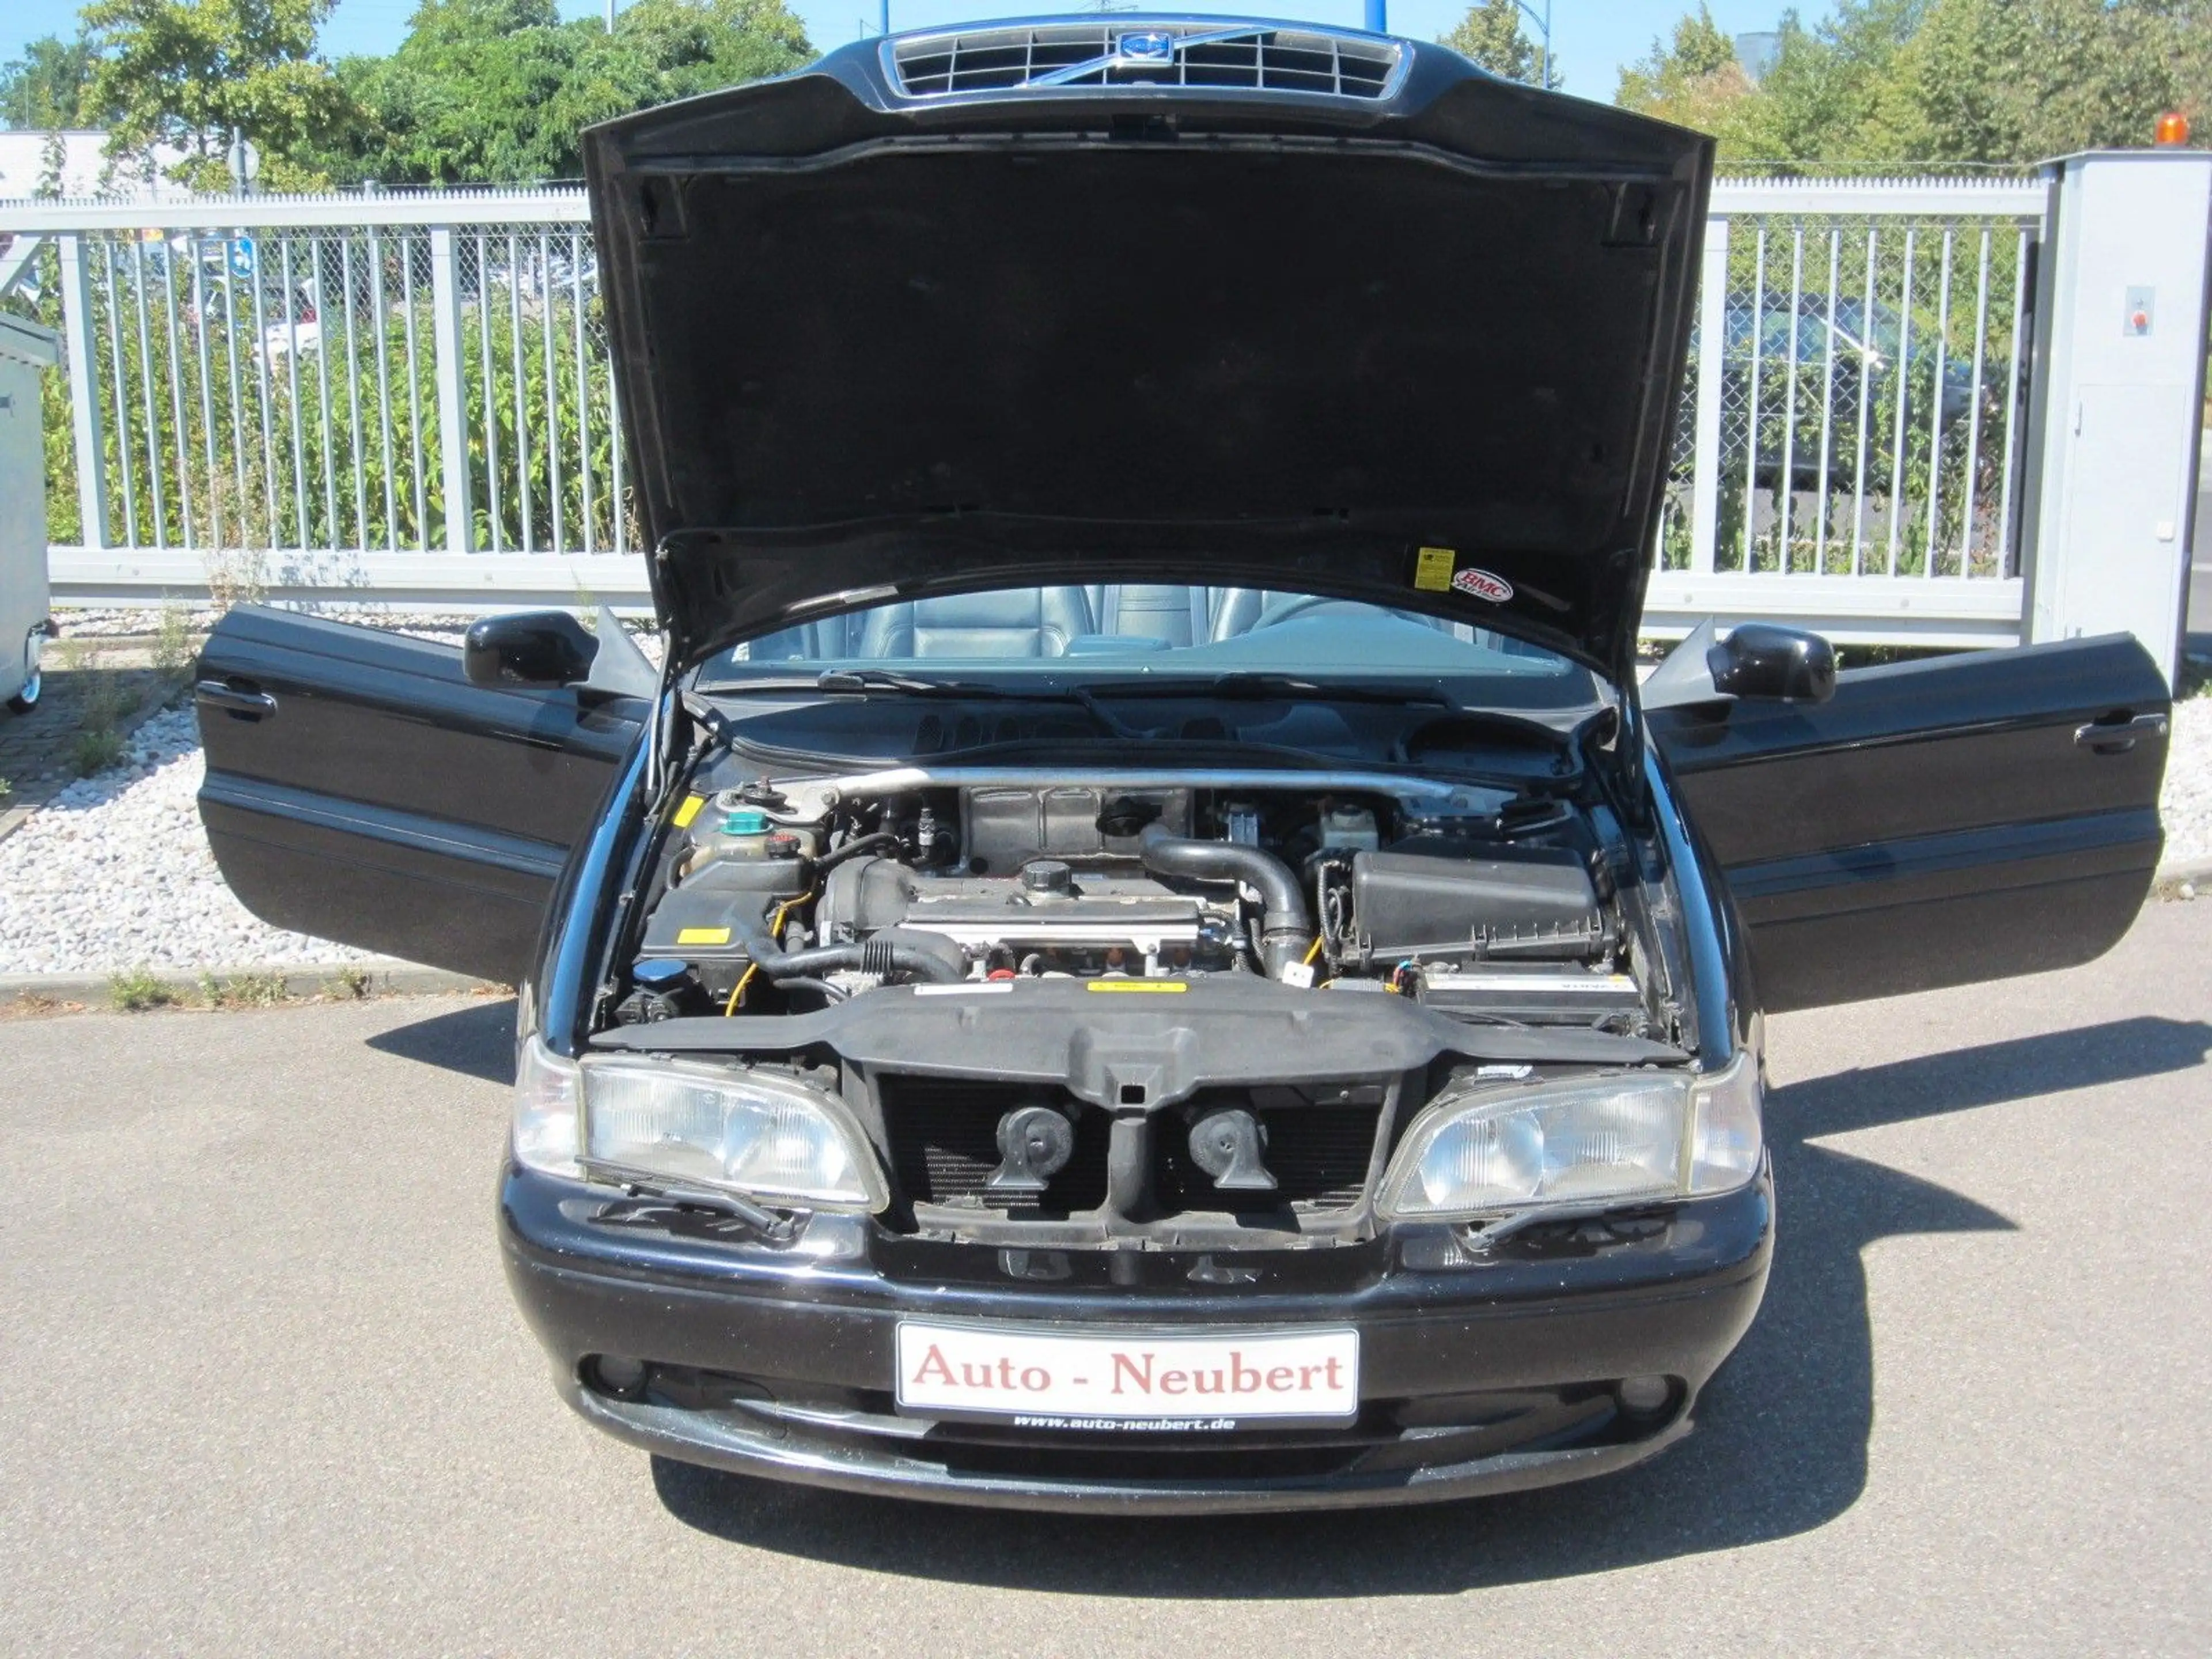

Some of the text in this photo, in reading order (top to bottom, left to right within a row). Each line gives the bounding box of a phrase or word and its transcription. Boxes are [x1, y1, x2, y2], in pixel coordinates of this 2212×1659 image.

[1461, 572, 1505, 597] BMC
[914, 1344, 1051, 1391] Auto
[1111, 1352, 1344, 1395] Neubert
[1014, 1415, 1236, 1430] www.auto-neubert.de
